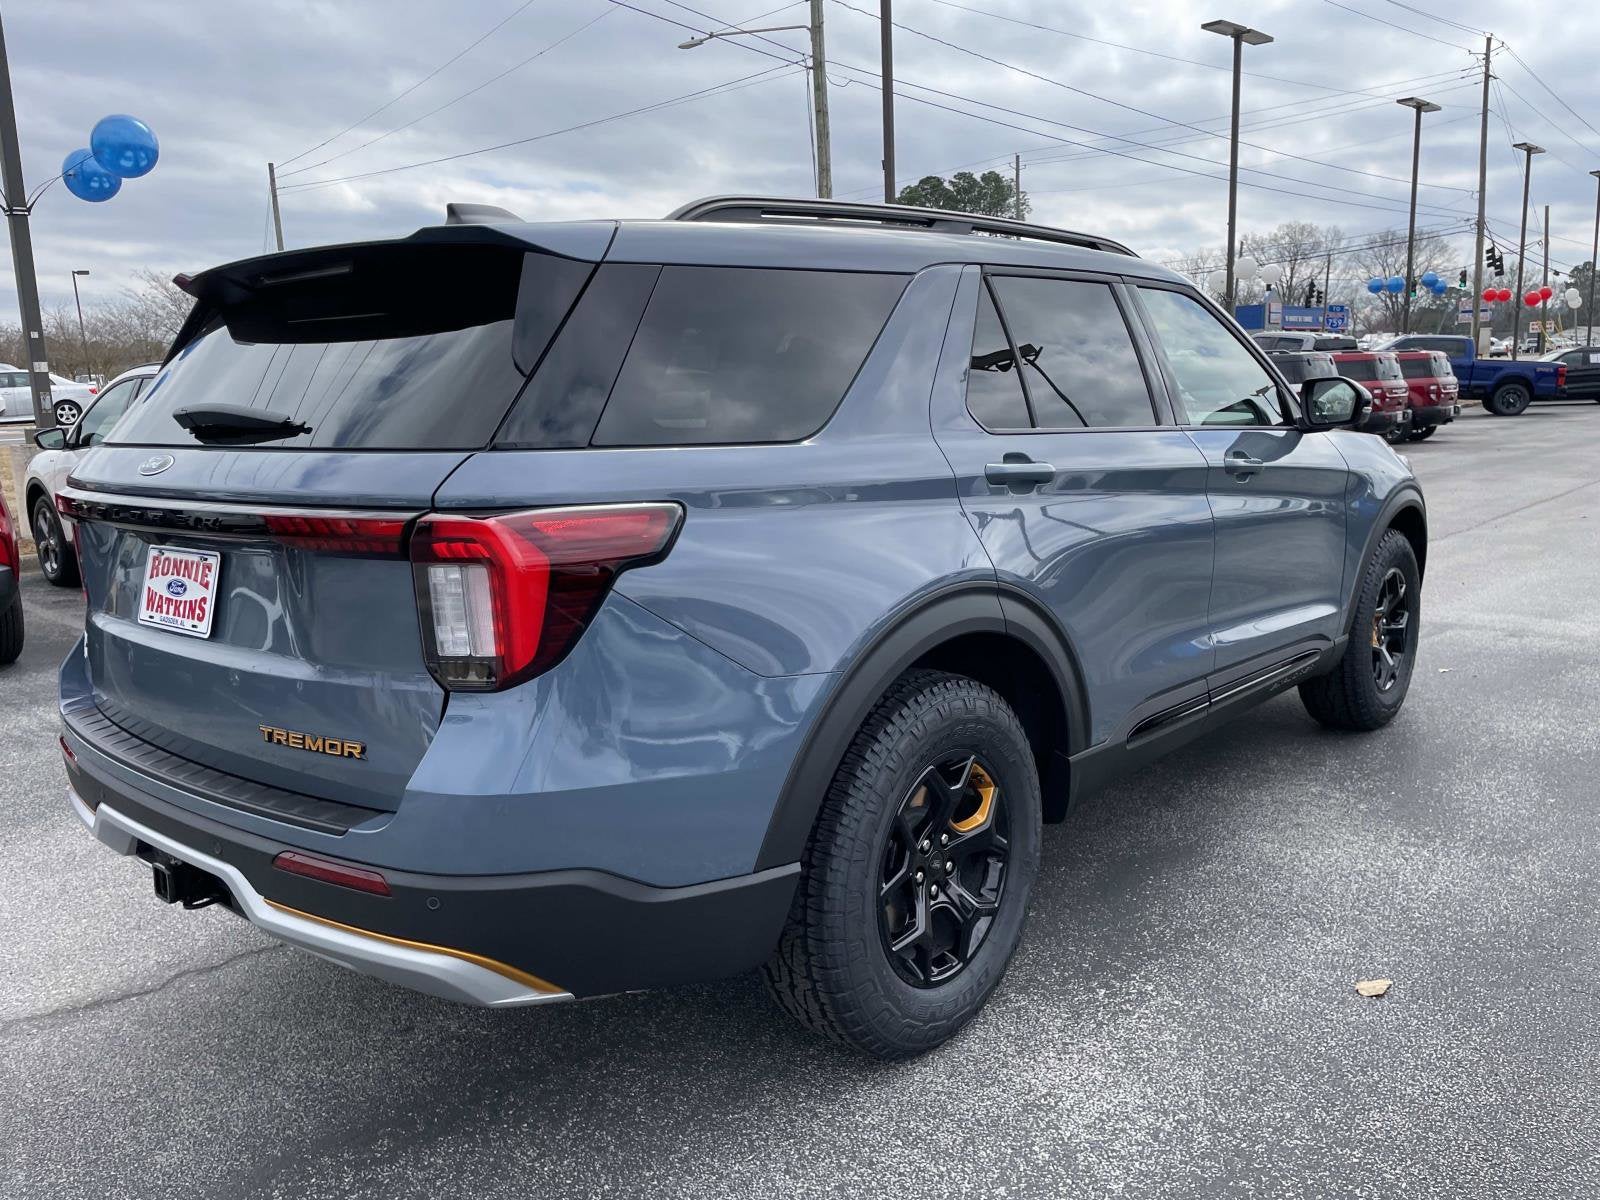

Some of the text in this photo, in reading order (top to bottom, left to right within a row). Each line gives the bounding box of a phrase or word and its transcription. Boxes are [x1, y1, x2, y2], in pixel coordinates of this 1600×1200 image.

[1328, 318, 1342, 328] 759
[150, 555, 213, 590] RONNIE
[169, 580, 186, 593] Ford
[146, 586, 208, 623] WATKINS
[259, 724, 366, 760] TREMOR
